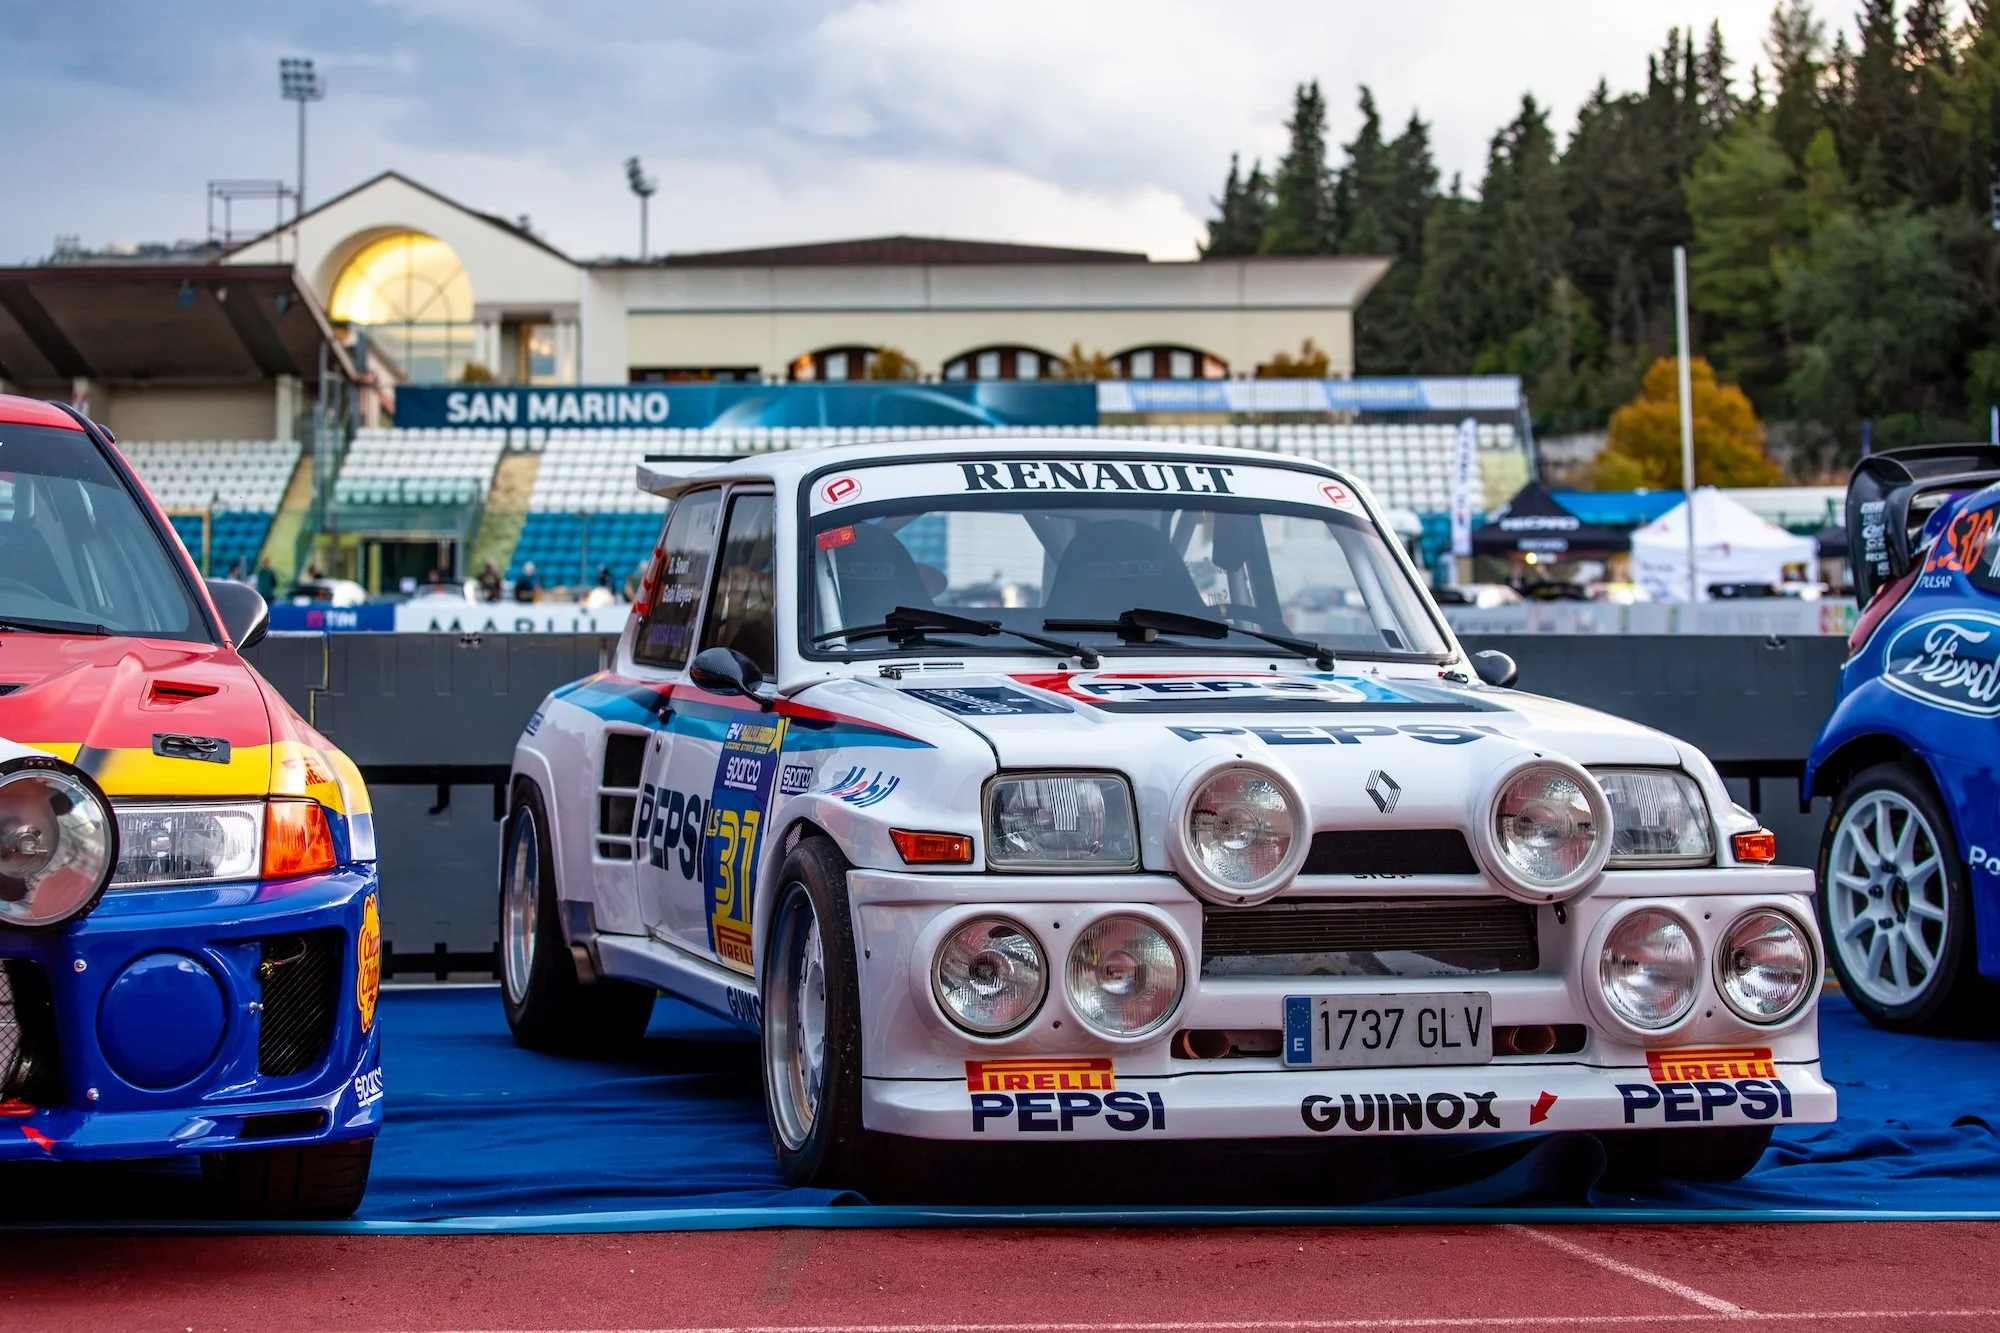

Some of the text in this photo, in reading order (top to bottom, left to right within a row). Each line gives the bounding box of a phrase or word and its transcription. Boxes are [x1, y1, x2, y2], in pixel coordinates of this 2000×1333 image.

[446, 392, 670, 423] SAN MARINO
[957, 462, 1235, 494] RENAULT
[1920, 576, 1952, 588] PULSAR
[1898, 623, 2000, 702] Ford
[1079, 681, 1356, 694] PEPSI
[725, 757, 761, 788] sparco
[782, 767, 812, 792] sparco
[636, 783, 711, 883] PEPSI
[717, 924, 754, 967] PIRELLI
[1293, 1006, 1483, 1052] E 1737 GLV
[965, 1058, 1113, 1092] PIRELLI
[1646, 1048, 1778, 1081] PIRELLI
[971, 1091, 1166, 1132] PEPSI
[1301, 1091, 1500, 1132] GUINOX
[1615, 1080, 1793, 1123] PEPSI
